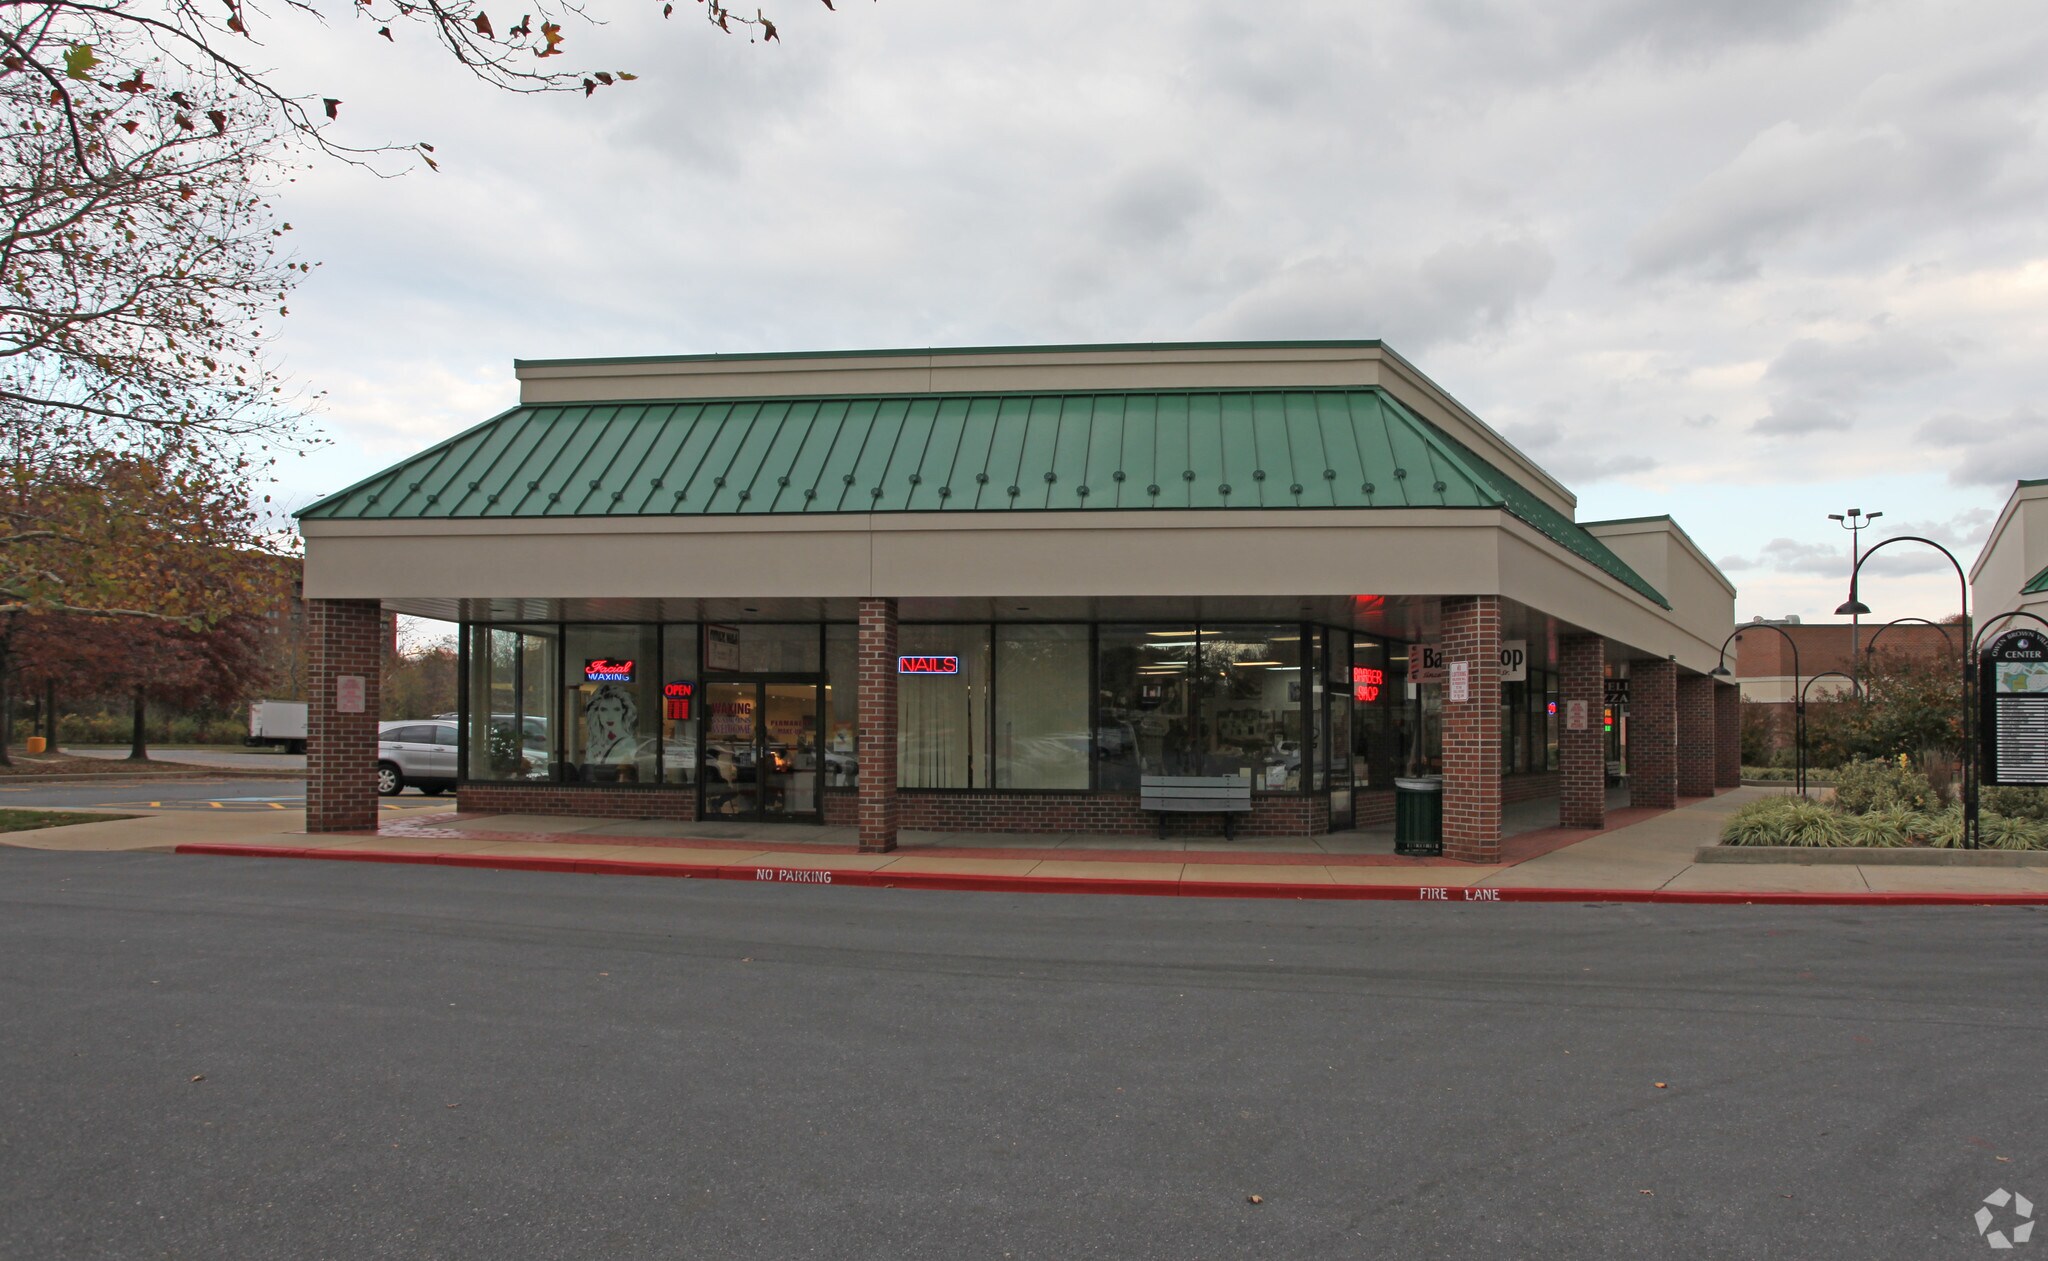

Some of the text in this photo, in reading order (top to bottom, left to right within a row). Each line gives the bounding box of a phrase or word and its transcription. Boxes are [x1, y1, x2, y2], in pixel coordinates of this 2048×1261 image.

[1991, 637, 2006, 657] OWEN
[2006, 631, 2034, 639] BROWN
[1423, 648, 1523, 671] Ba op
[2005, 650, 2042, 658] CENTER
[585, 660, 632, 674] Facial
[901, 657, 956, 672] NAILS
[588, 673, 630, 681] WAXING
[1354, 667, 1383, 684] BARBER
[665, 684, 691, 696] OPEN
[1357, 685, 1379, 701] SHOP
[1607, 682, 1629, 691] ELI
[712, 702, 751, 714] WAXING
[756, 868, 832, 884] NO PARKING
[1420, 887, 1501, 901] FIRE LANE
